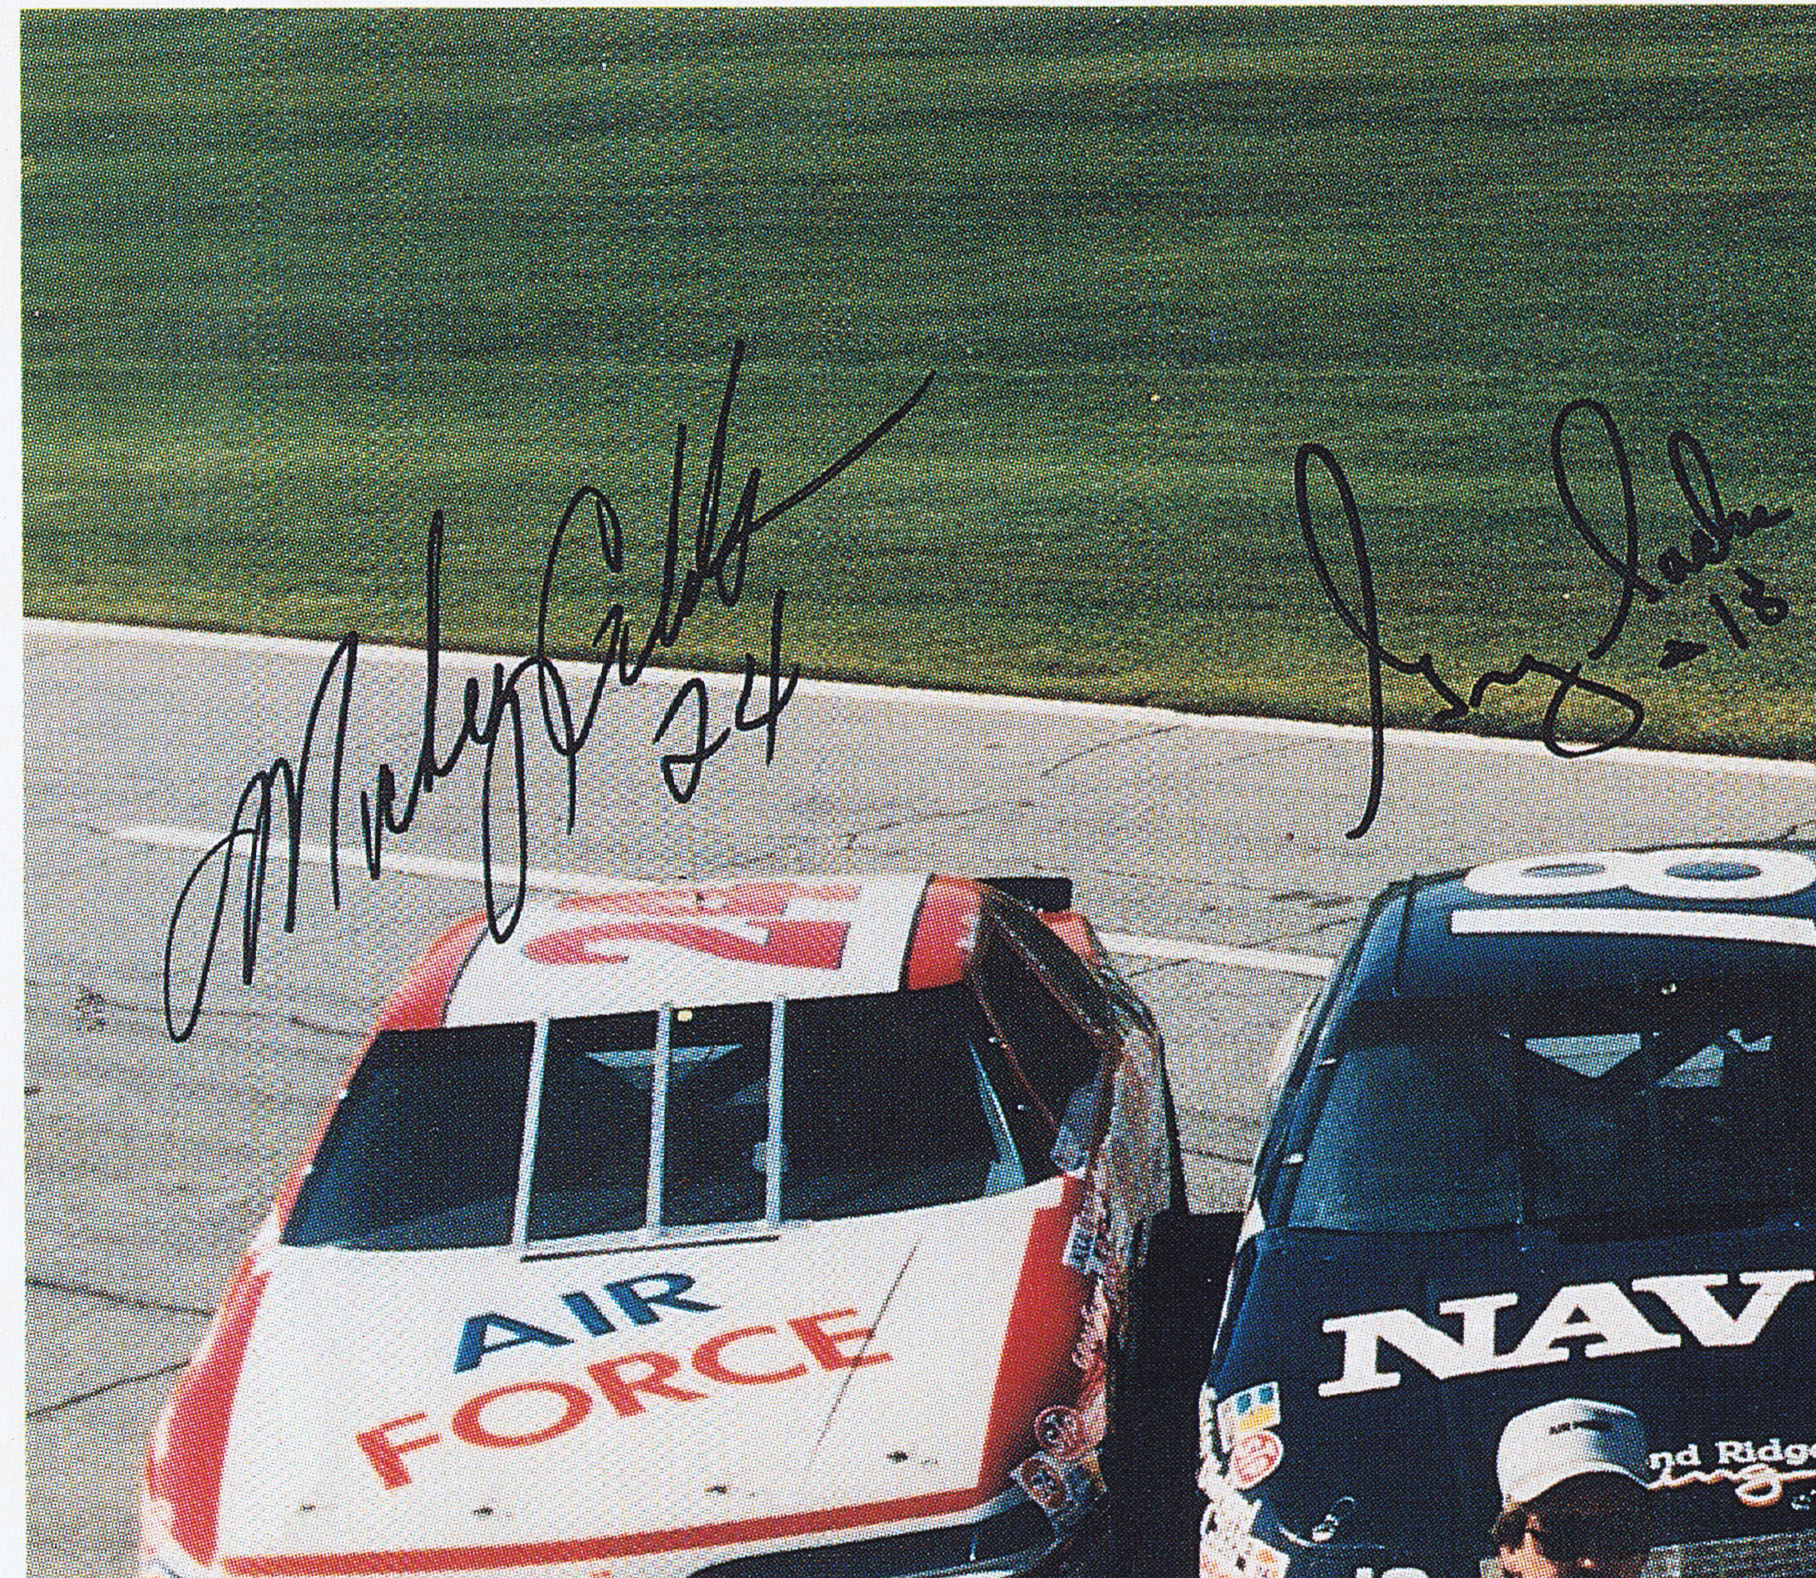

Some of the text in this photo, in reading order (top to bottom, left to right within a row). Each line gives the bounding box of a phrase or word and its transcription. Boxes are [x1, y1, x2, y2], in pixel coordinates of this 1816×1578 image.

[652, 586, 801, 803] 24
[355, 1307, 894, 1492] FORCE
[452, 1271, 720, 1374] AIR
